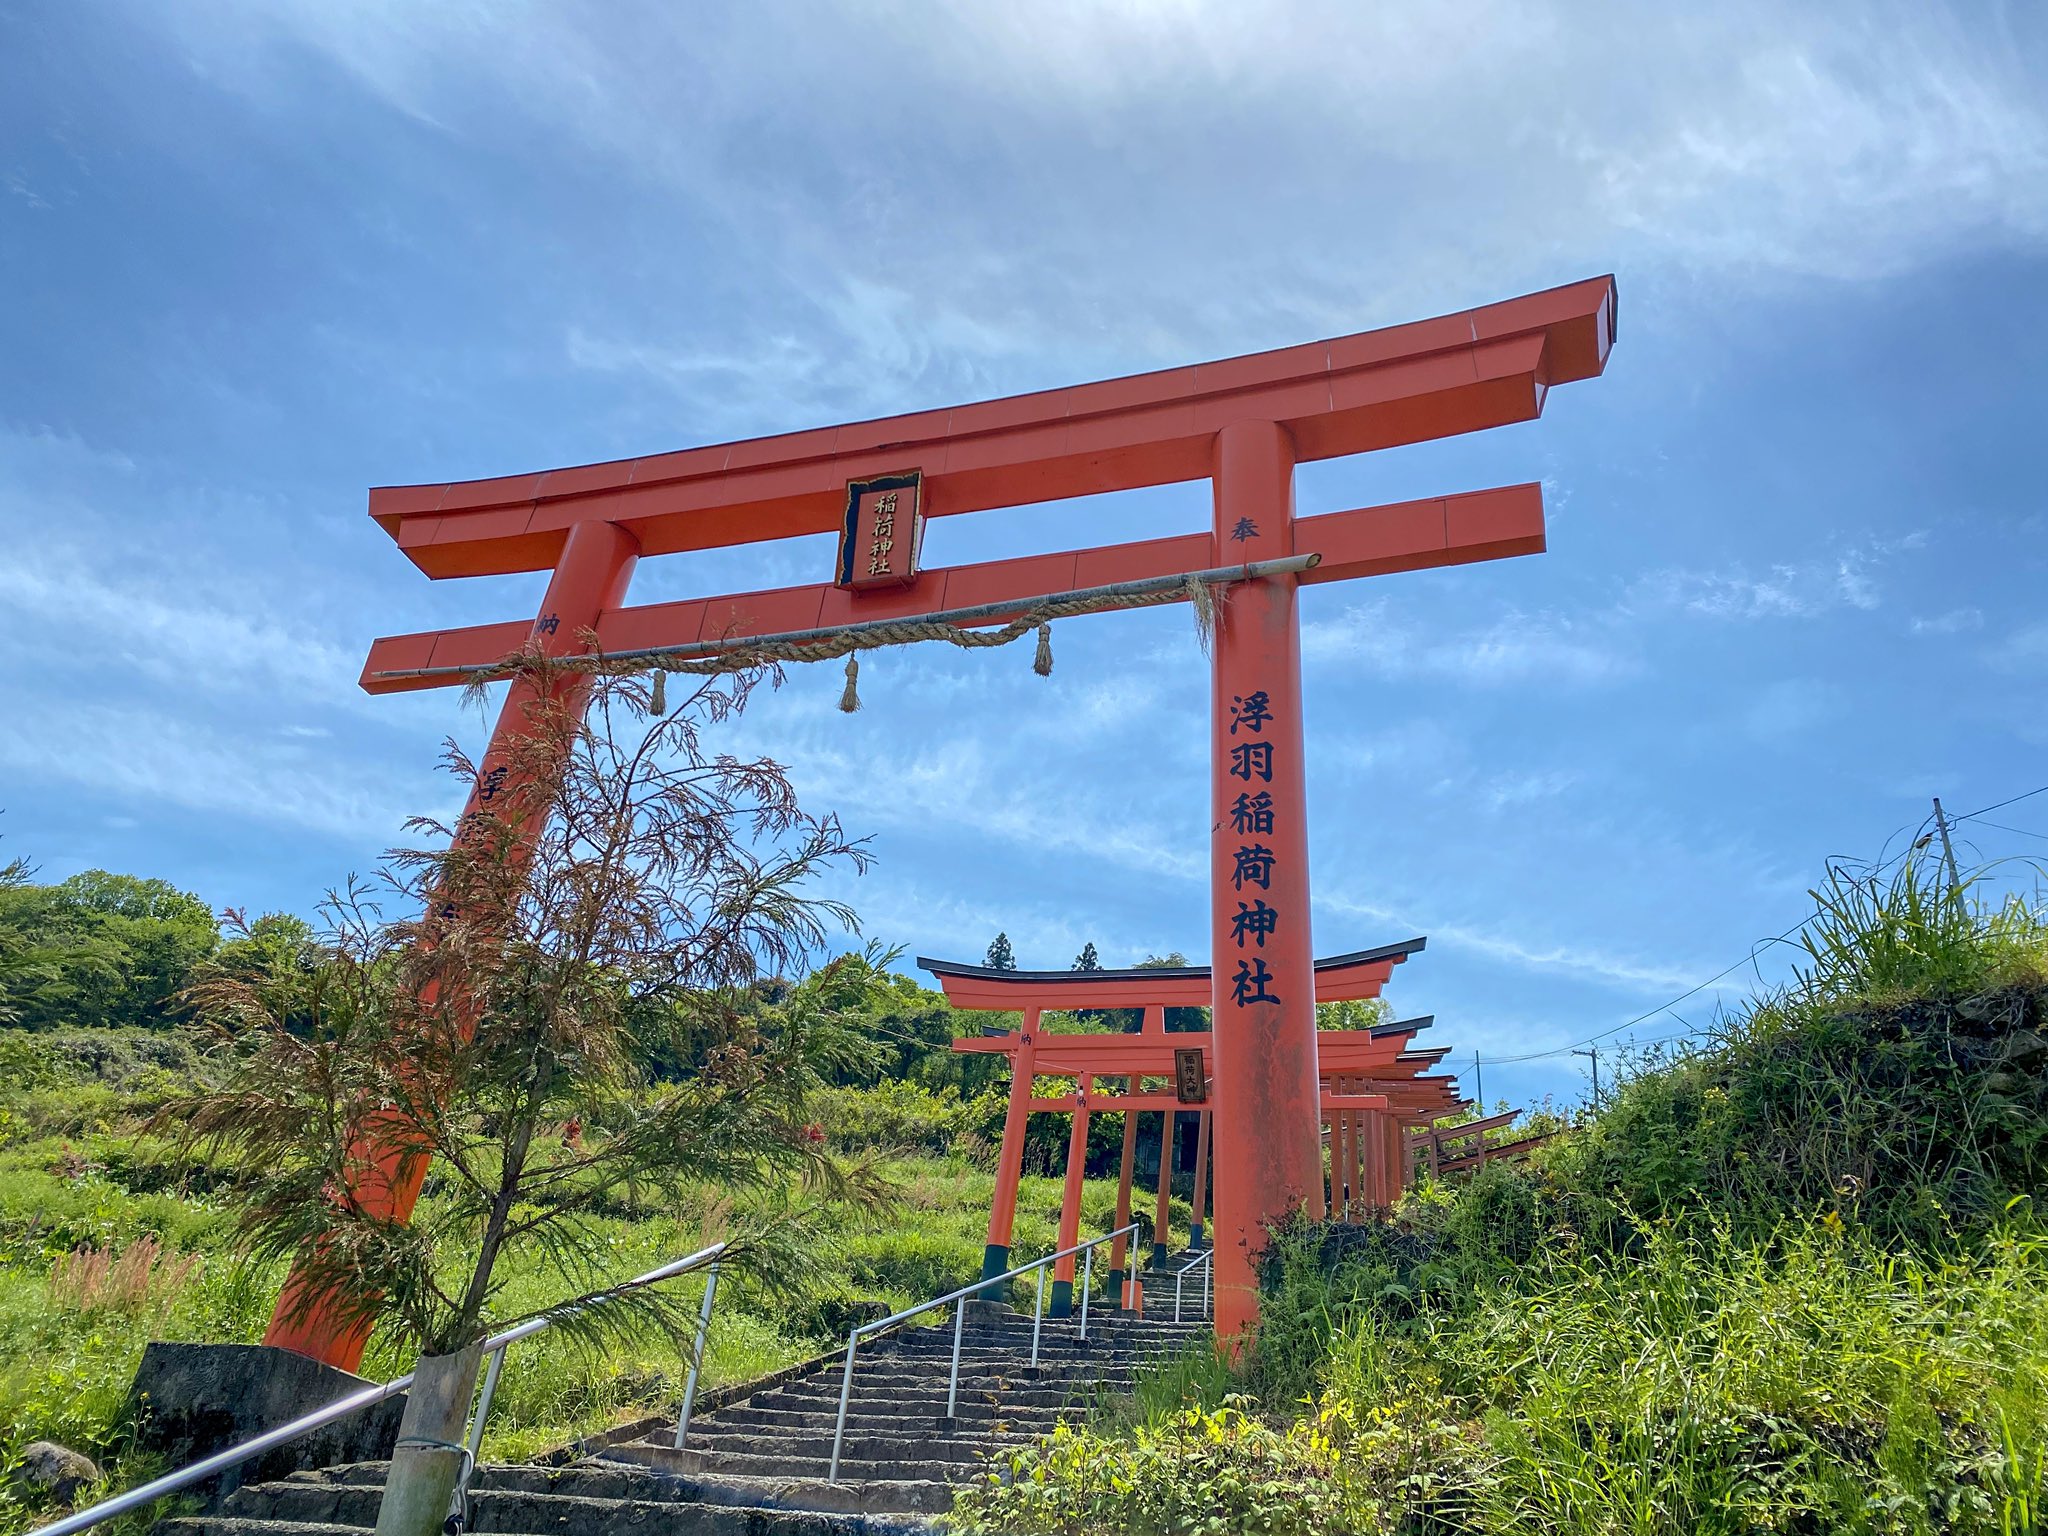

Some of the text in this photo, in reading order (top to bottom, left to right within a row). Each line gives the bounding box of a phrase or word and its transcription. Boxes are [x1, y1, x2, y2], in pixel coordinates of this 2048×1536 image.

[868, 492, 898, 576] 稲荷神社
[1229, 517, 1261, 543] 奉
[534, 613, 561, 636] 納
[1230, 691, 1281, 1008] 浮羽稲荷神社
